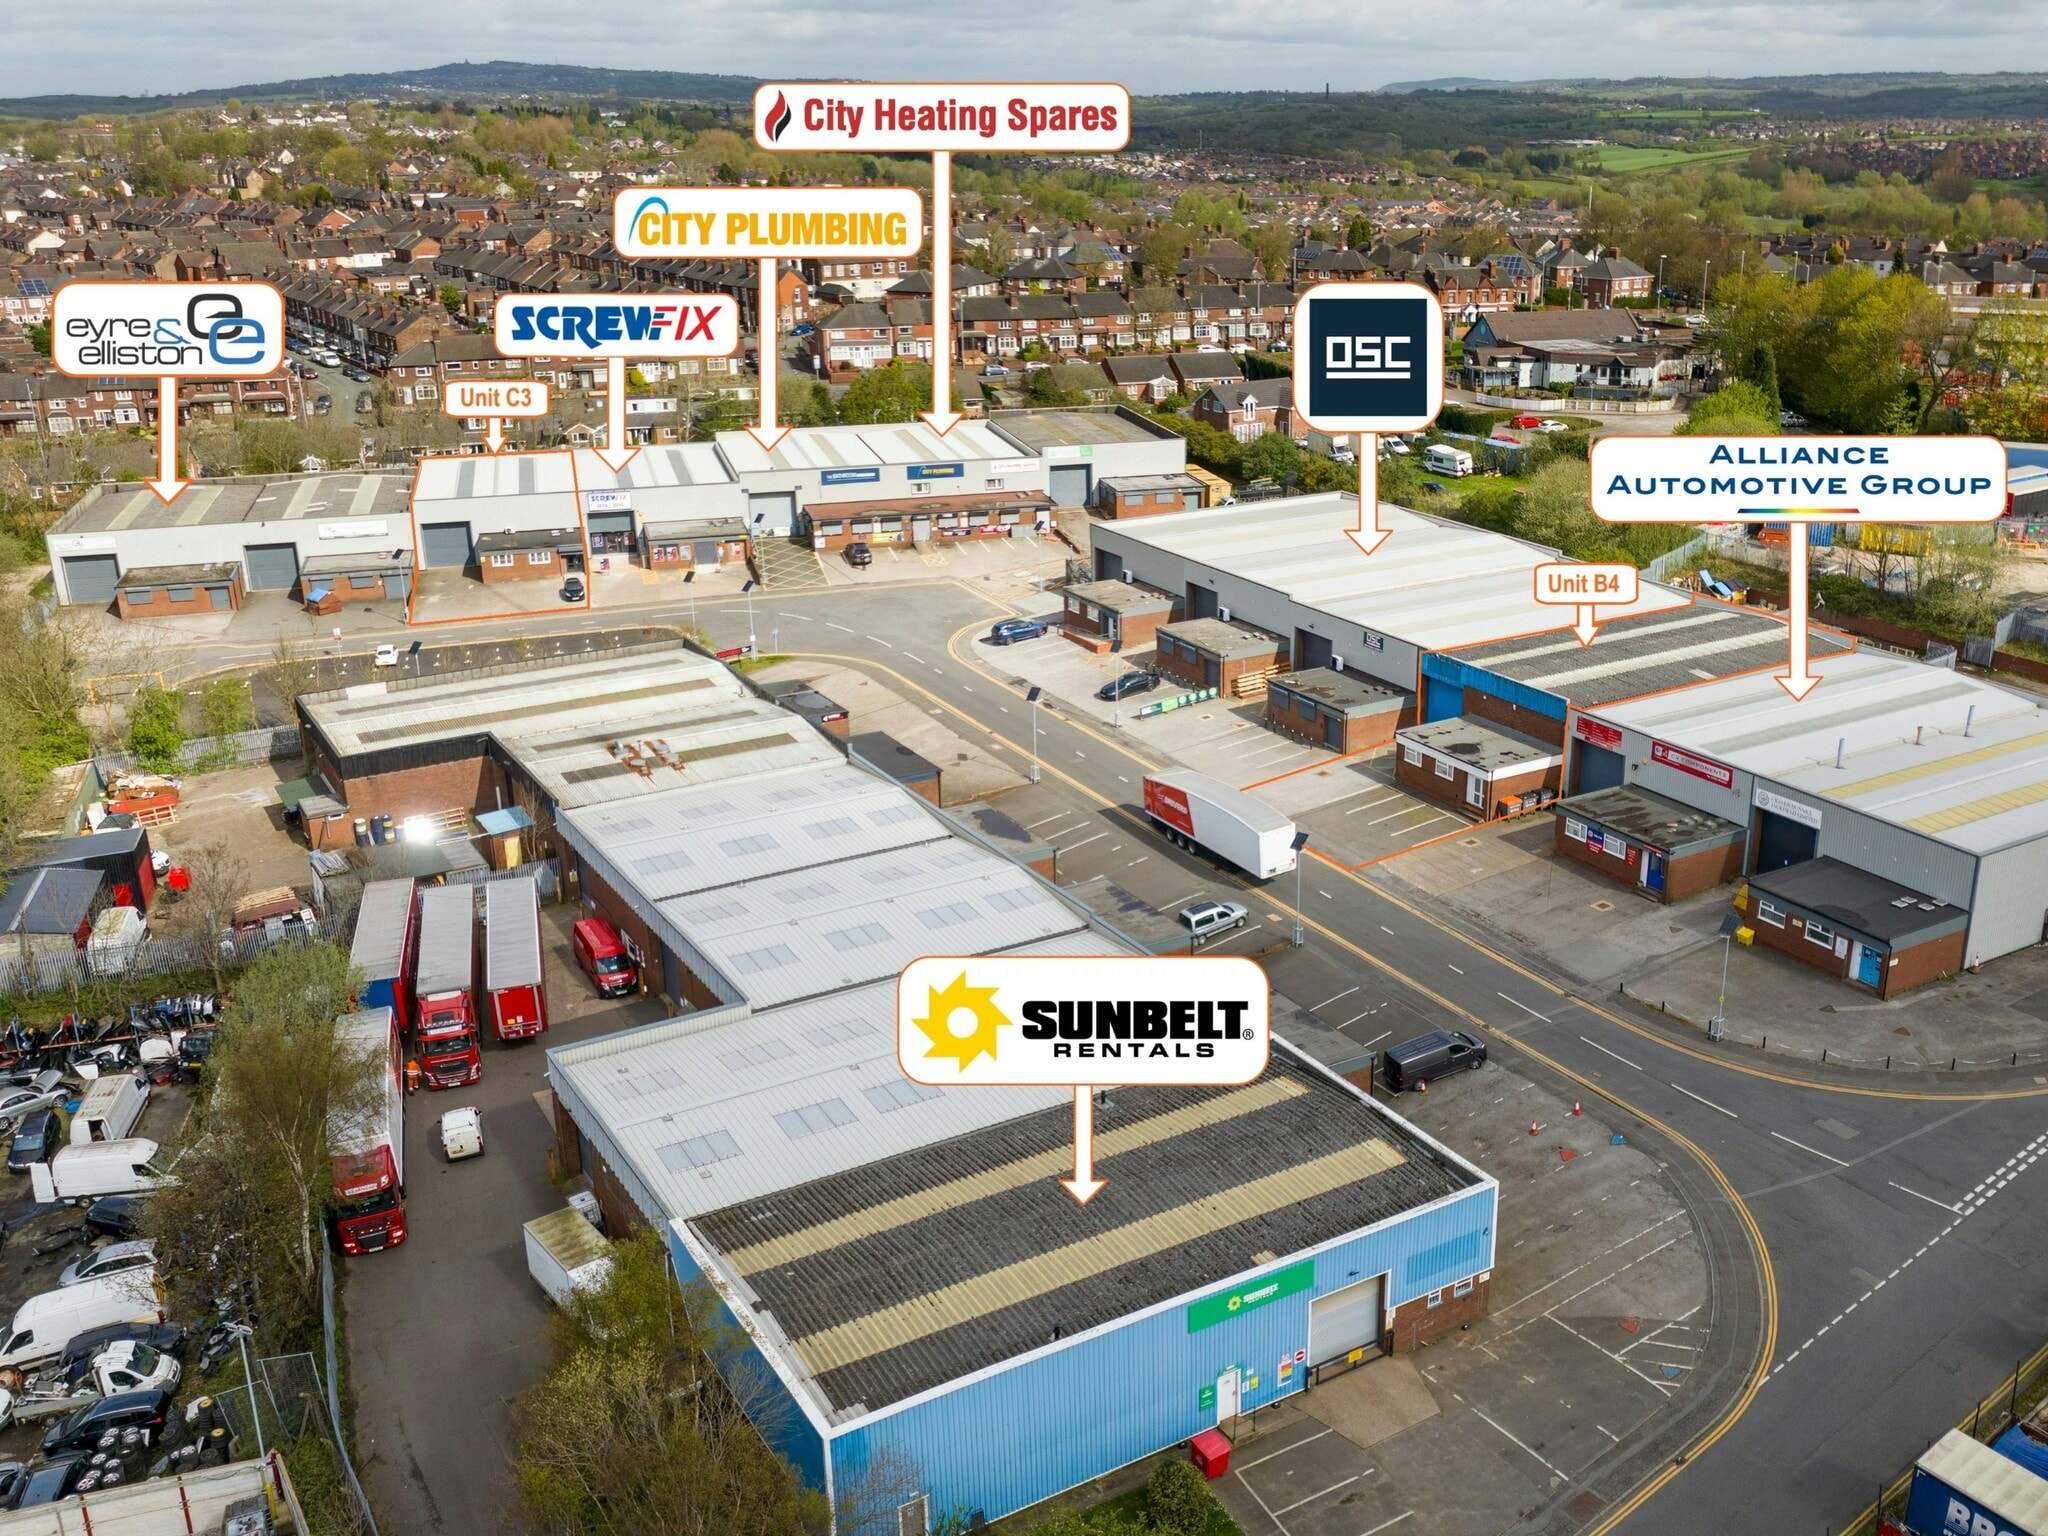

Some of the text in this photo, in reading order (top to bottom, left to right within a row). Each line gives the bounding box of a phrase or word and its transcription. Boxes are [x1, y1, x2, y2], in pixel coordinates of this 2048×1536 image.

[1670, 753, 1681, 761] CV
[1681, 756, 1727, 779] COMPONENTS
[1243, 1283, 1279, 1303] SUNBELT
[1944, 1497, 2017, 1536] BR
